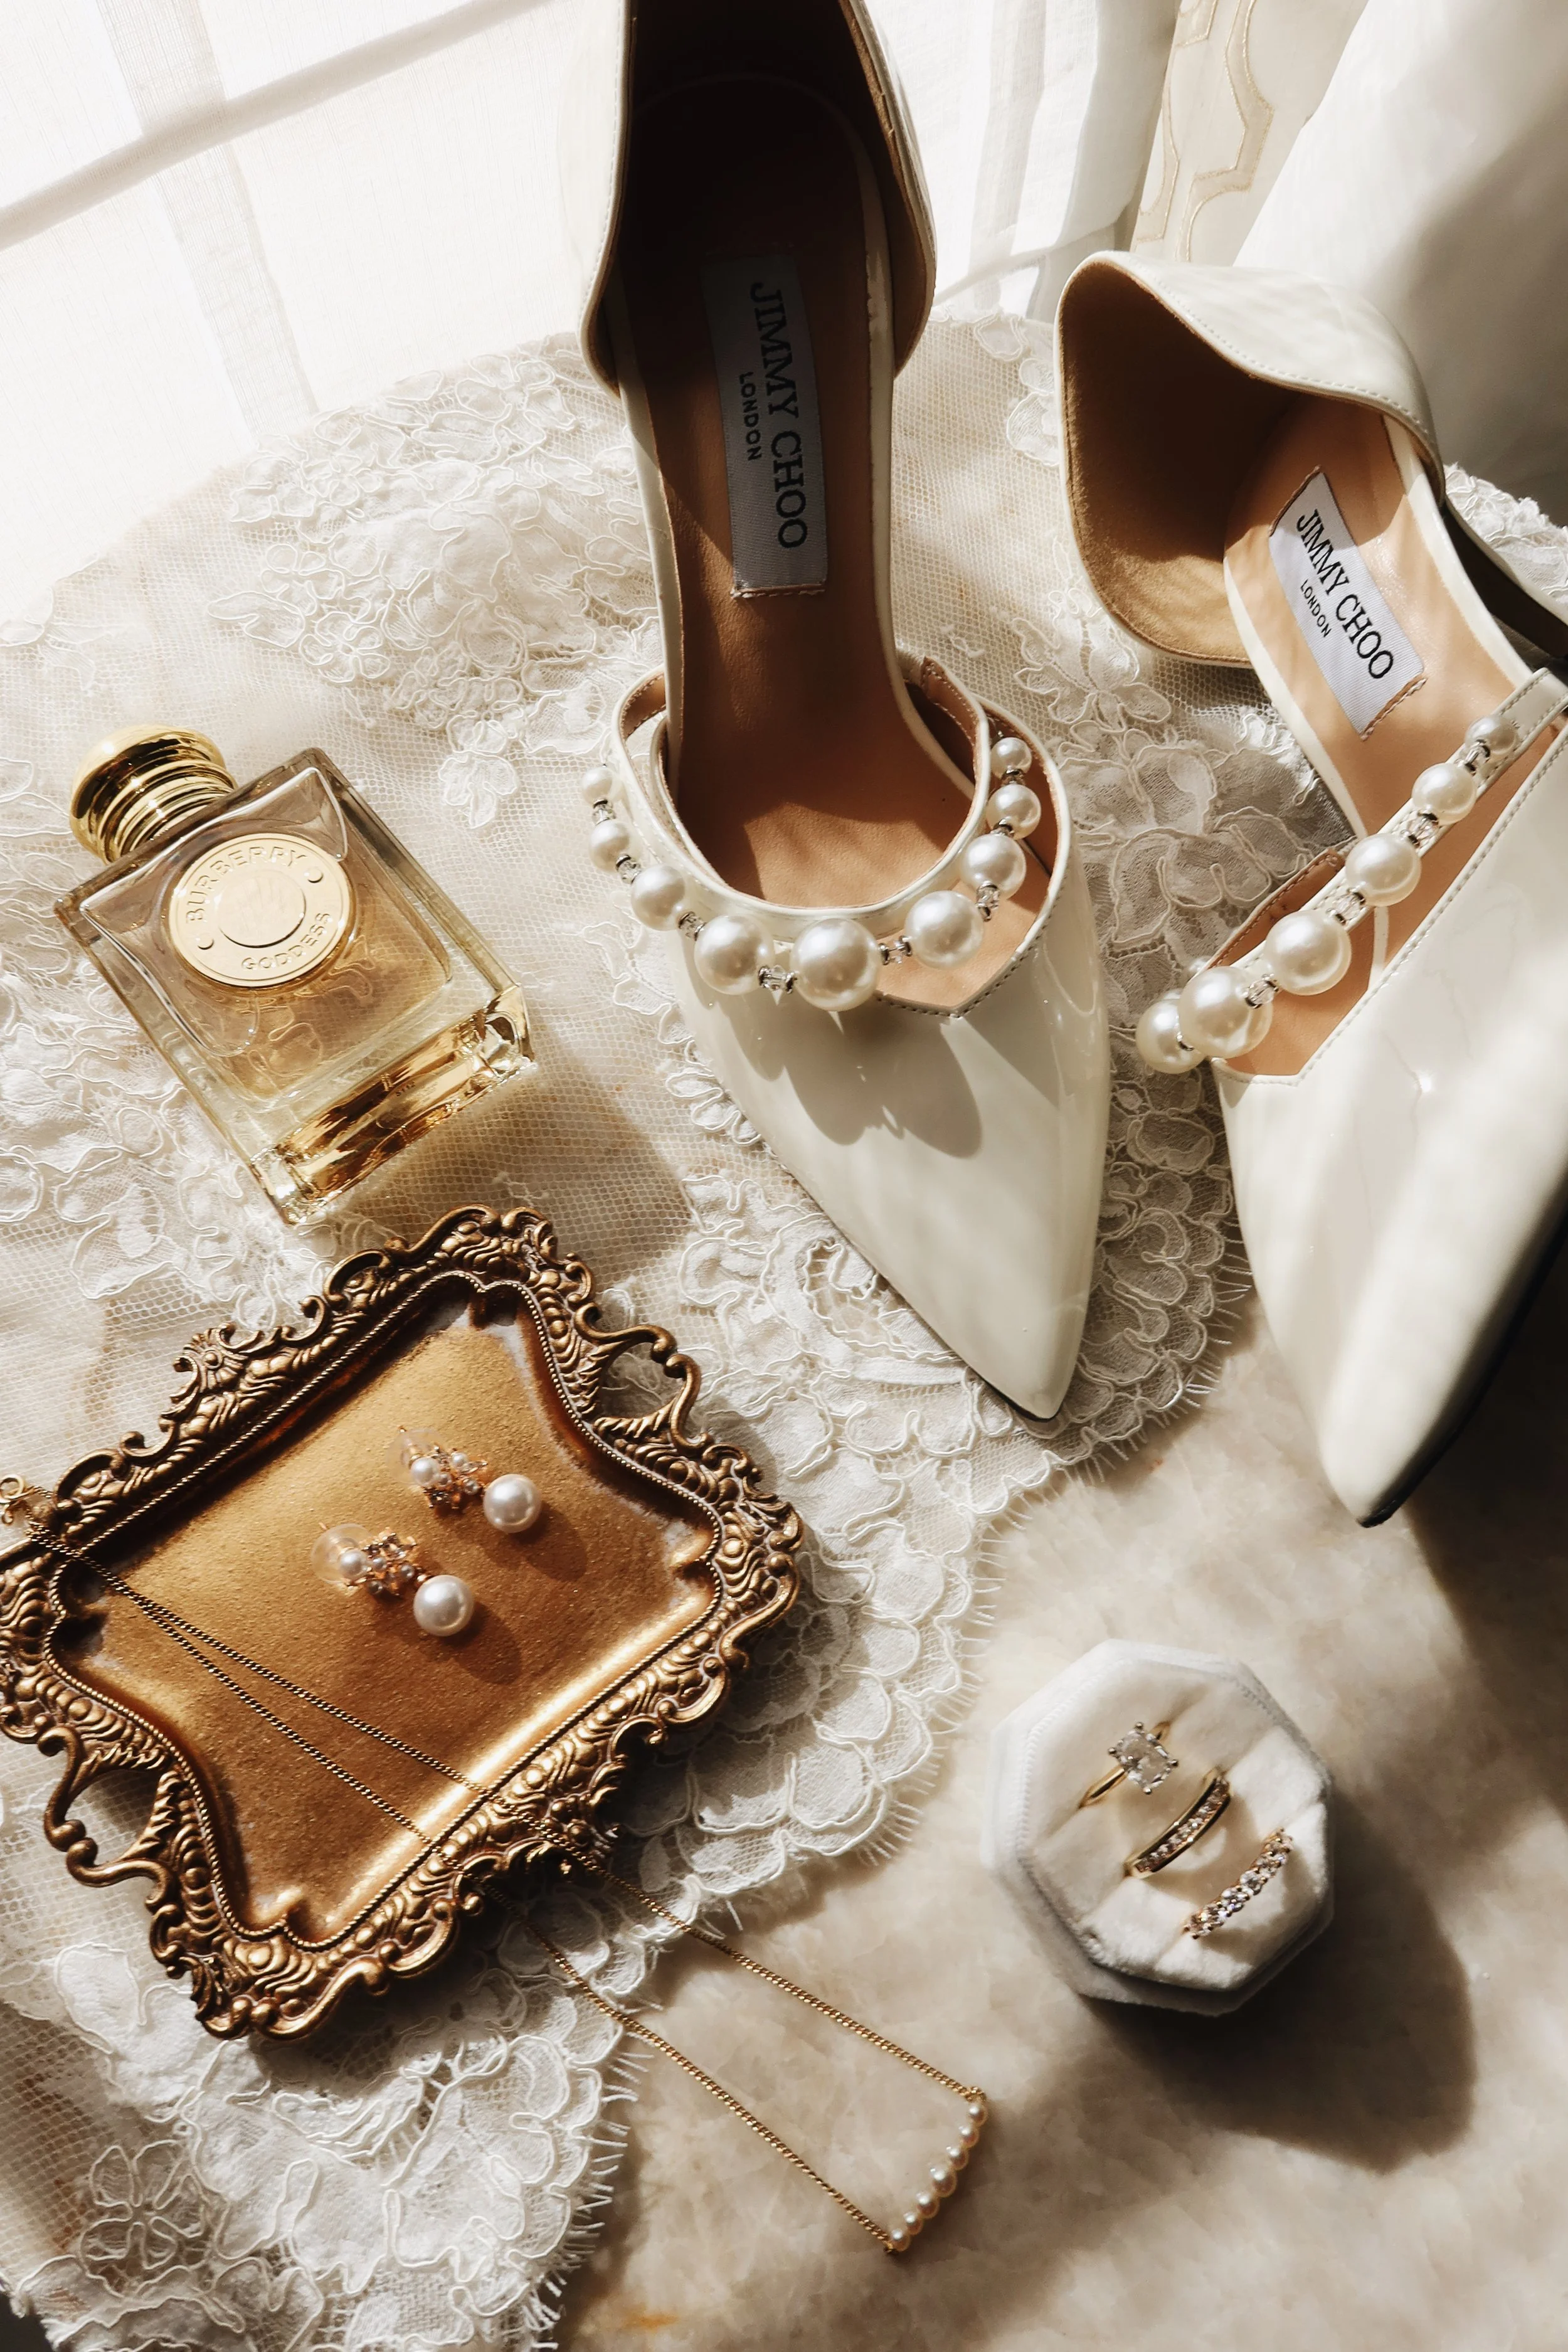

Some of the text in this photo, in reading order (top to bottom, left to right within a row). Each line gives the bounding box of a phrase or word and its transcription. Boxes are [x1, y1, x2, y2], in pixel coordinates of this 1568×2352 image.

[739, 371, 761, 460] LONDON
[750, 282, 808, 548] JIMMY CHOO
[1296, 509, 1394, 679] JIMMY CHOO
[1300, 580, 1332, 637] LONDON
[186, 846, 307, 924] BURBERRY
[241, 912, 333, 970] GODDESS
